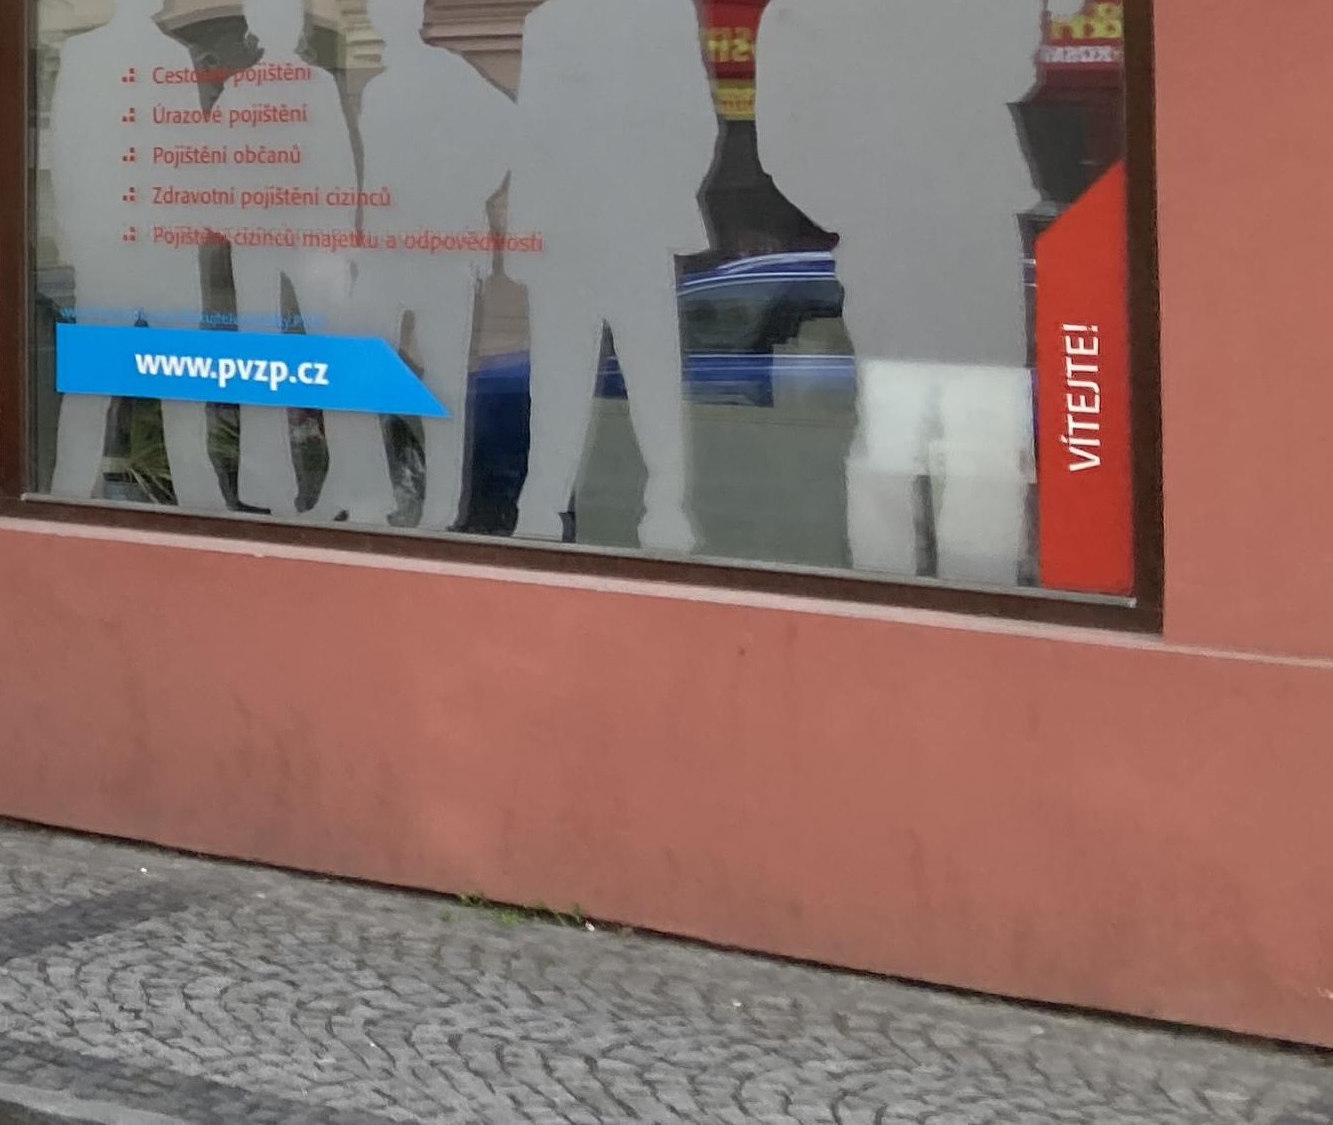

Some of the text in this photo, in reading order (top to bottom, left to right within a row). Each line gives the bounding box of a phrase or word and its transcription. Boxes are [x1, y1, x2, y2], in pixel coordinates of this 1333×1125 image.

[152, 63, 227, 85] Cesto
[153, 103, 307, 128] Úrazové pojištění
[153, 145, 301, 168] Pojištění občanů
[152, 184, 391, 209] Zdravotní pojištění cizinců
[386, 235, 397, 249] a
[404, 228, 543, 254] odpovědosti
[134, 353, 330, 392] www.pvzp.cz
[1060, 323, 1101, 472] VÍTEJTE!
